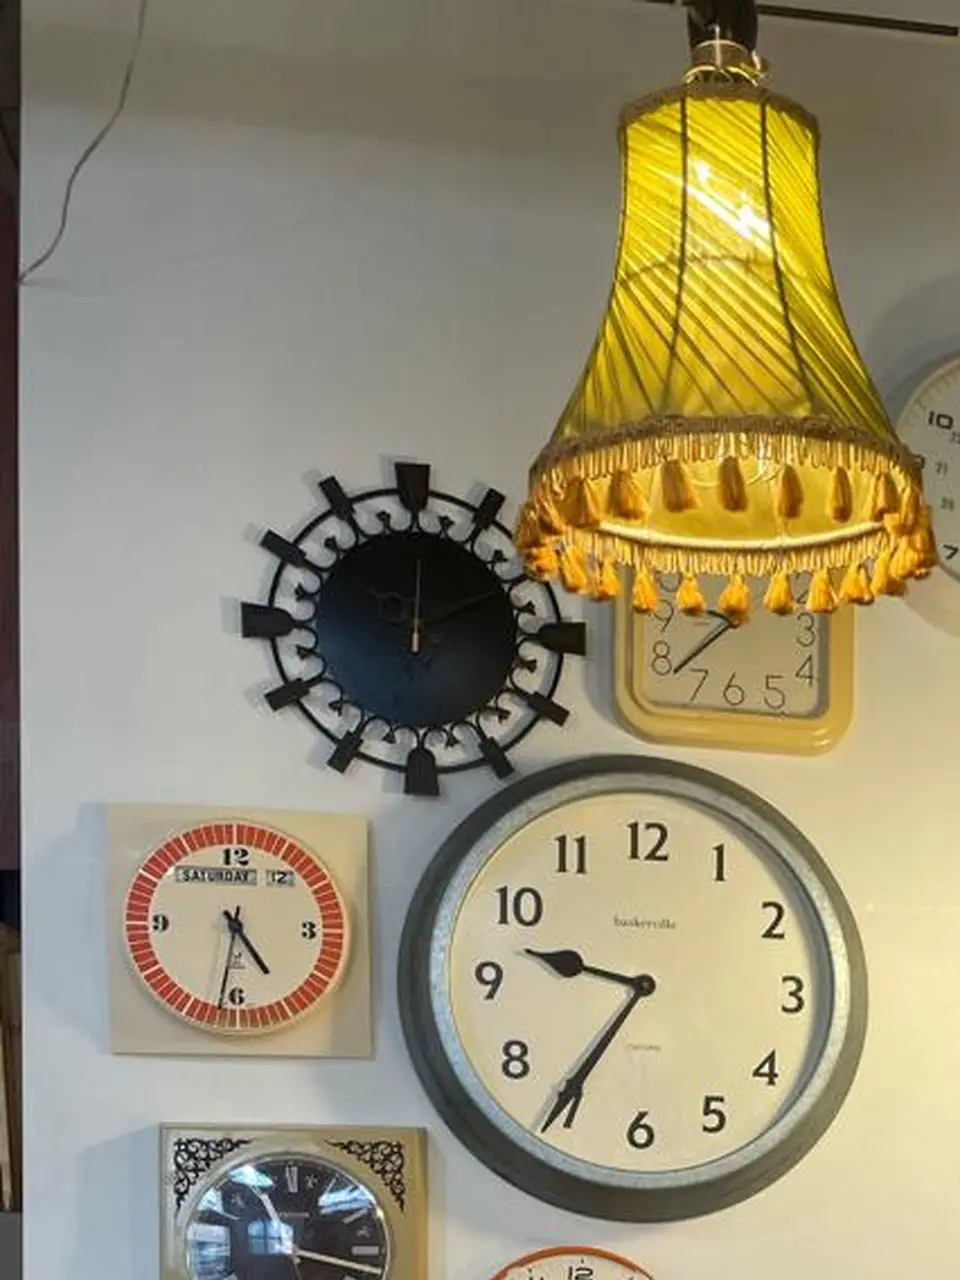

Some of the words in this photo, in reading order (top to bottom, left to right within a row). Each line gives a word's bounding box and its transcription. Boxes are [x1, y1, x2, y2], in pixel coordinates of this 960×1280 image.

[927, 410, 954, 430] 10
[941, 543, 960, 560] 7
[796, 611, 818, 649] 3
[650, 638, 674, 677] 8
[794, 652, 815, 690] 4
[688, 666, 710, 705] 7
[722, 669, 746, 707] 6
[763, 673, 787, 711] 5
[221, 847, 250, 867] 12
[553, 834, 588, 875] 11
[626, 820, 670, 862] 12
[182, 869, 250, 884] SATURDAY
[270, 869, 288, 885] 12
[711, 843, 727, 882] 1
[152, 914, 170, 932] 9
[495, 885, 544, 927] 10
[612, 913, 677, 930] baskerville
[760, 900, 786, 940] 2
[301, 920, 317, 941] 3
[228, 987, 245, 1006] 6
[474, 960, 504, 1000] 9
[780, 975, 805, 1014] 3
[501, 1039, 531, 1080] 8
[751, 1048, 780, 1087] 4
[625, 1110, 656, 1150] 6
[701, 1095, 728, 1134] 5
